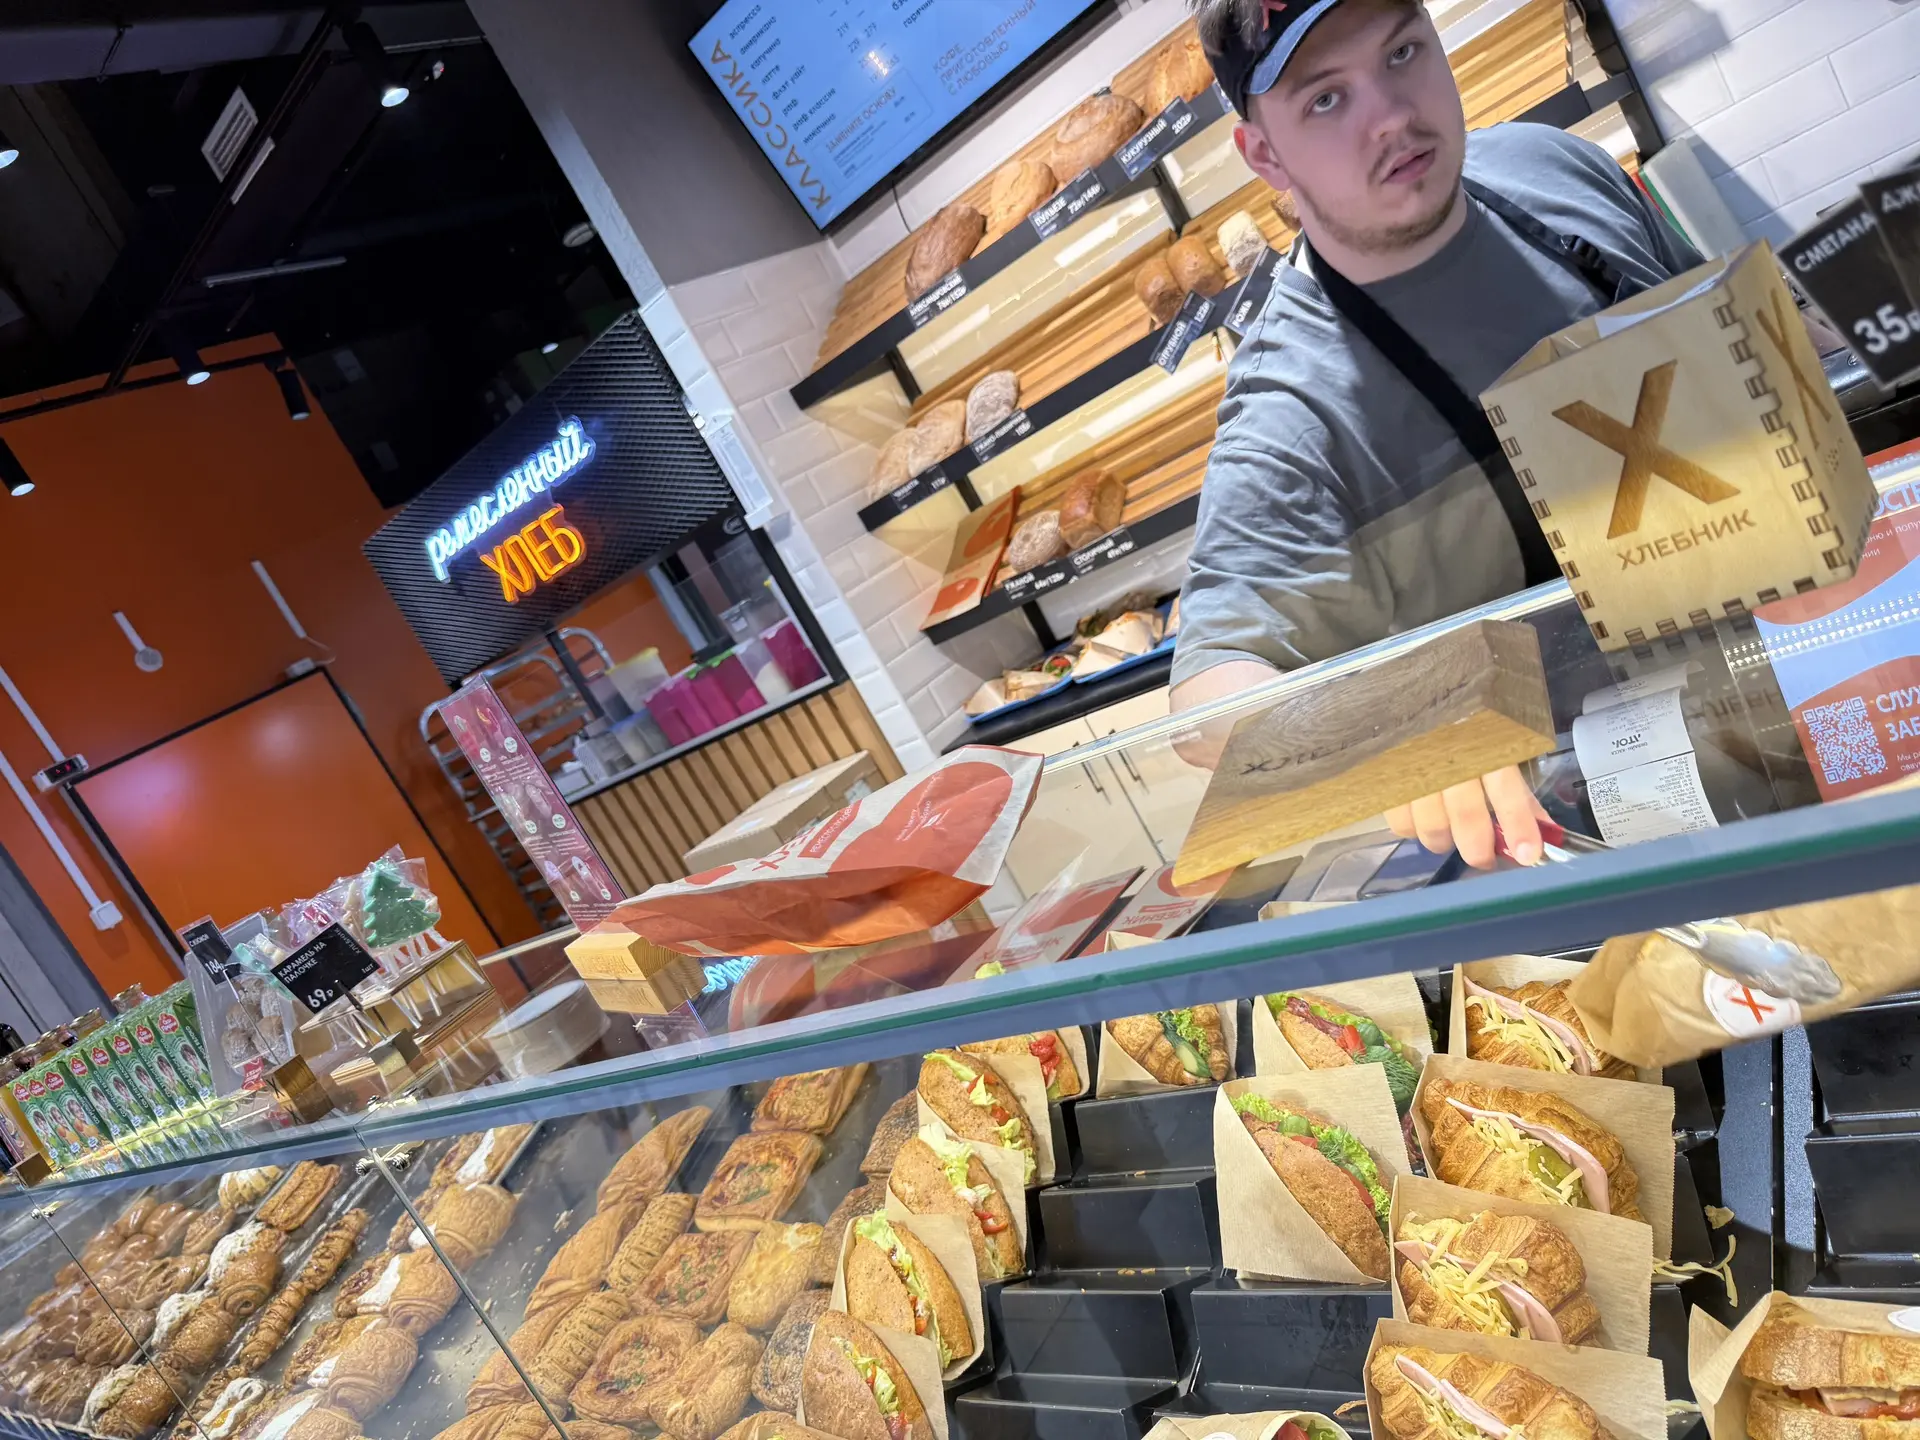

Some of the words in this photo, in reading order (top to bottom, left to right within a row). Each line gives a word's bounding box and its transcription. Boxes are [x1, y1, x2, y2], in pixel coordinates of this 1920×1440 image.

[740, 16, 777, 55] американо
[750, 38, 781, 69] капучино
[761, 64, 780, 85] латте
[933, 43, 965, 74] КОФЕ
[956, 40, 1009, 90] ЛЮБОВЬЮ
[711, 39, 831, 209] КЛАССИКА
[782, 98, 799, 117] раф
[792, 112, 809, 131] раф
[1120, 117, 1168, 165] КУКУРУЗНЫЙ
[1794, 211, 1878, 272] СМЕТАНА
[1158, 320, 1187, 366] ОТРУБНОЙ
[480, 504, 584, 603] ХЛЕБ
[1073, 538, 1115, 567] СТОЛИЧНЫЙ
[1616, 509, 1757, 571] ХЛЕБНИК
[278, 947, 315, 977] КАРАМЕЛЬ
[313, 941, 327, 954] НА
[283, 958, 318, 984] ПАЛОЧКЕ
